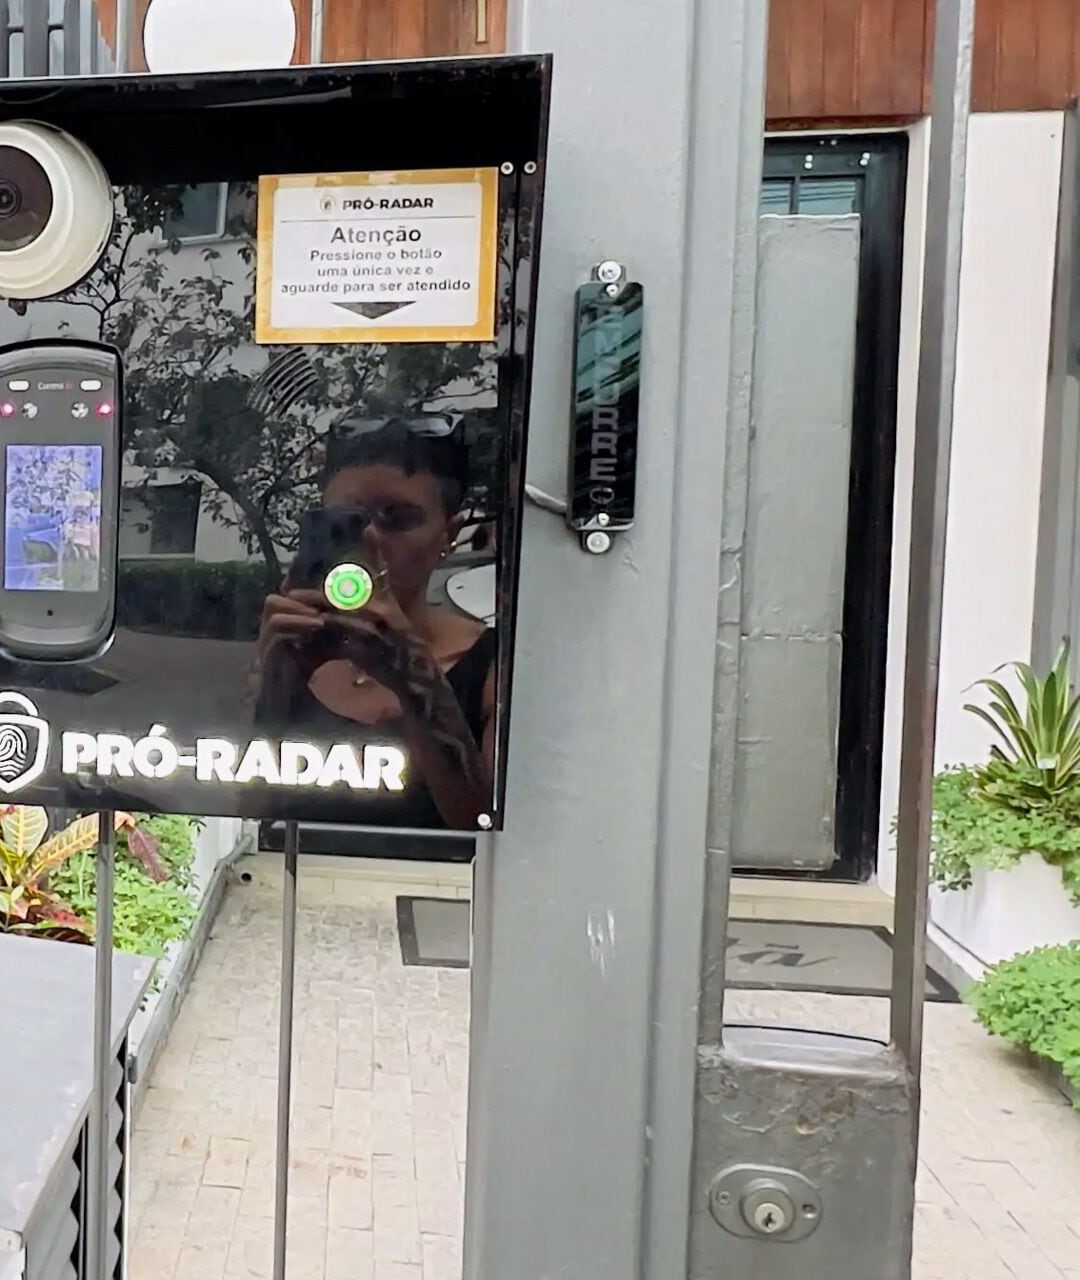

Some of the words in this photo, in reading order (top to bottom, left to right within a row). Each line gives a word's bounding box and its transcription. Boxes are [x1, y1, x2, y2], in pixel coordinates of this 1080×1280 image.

[342, 195, 434, 210] PRÓ-RADAR
[331, 226, 421, 246] Atenção
[310, 250, 382, 261] Pressione
[387, 251, 396, 260] o
[401, 248, 441, 259] botão
[318, 268, 347, 277] uma
[352, 264, 391, 276] única
[396, 267, 421, 275] vez
[281, 283, 338, 295] aguarde
[343, 283, 374, 294] para
[379, 282, 402, 291] ser
[407, 280, 470, 291] atendido
[61, 723, 405, 791] PRÓ-RADAR
